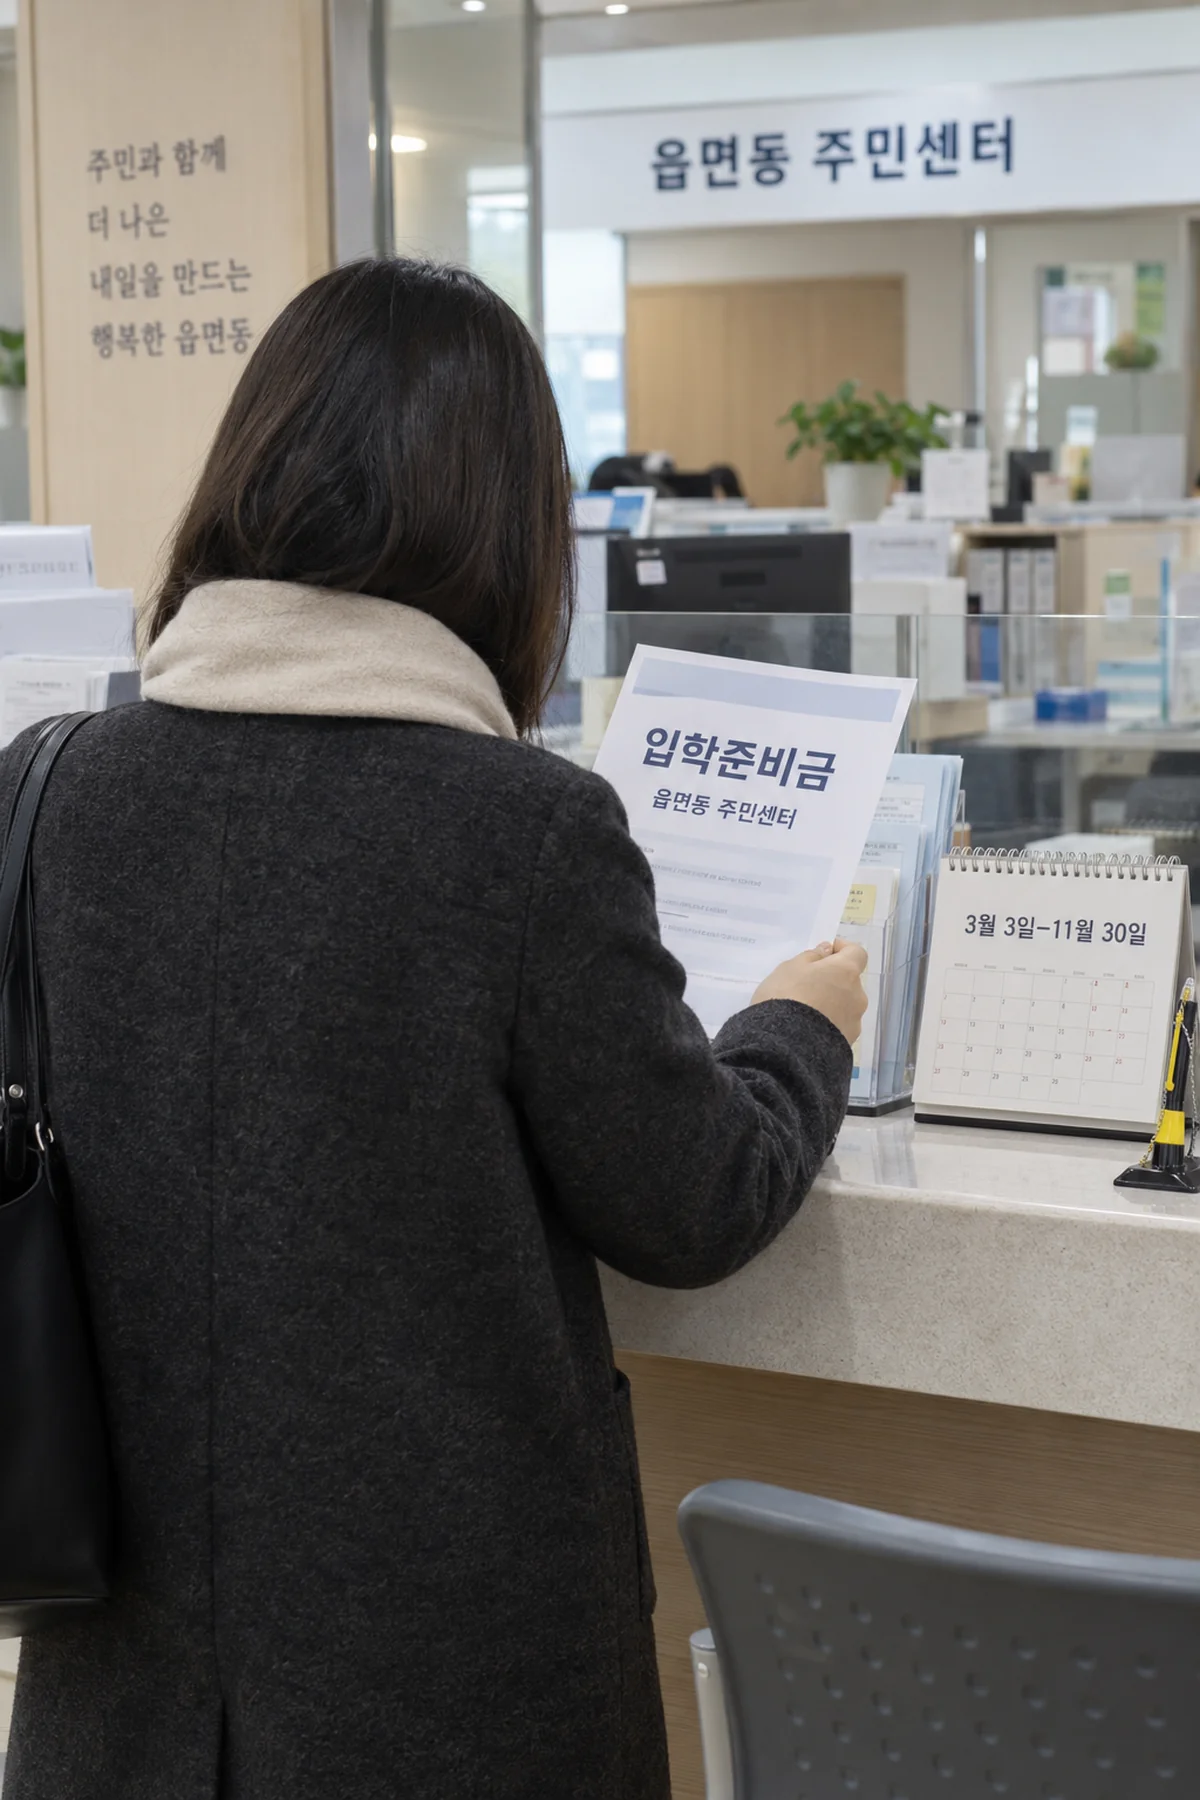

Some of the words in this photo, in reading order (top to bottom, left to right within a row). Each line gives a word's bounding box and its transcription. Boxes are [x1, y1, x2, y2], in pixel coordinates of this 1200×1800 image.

[87, 142, 163, 183] 주민과
[173, 135, 227, 177] 함께
[651, 132, 790, 192] 읍면동
[812, 115, 1013, 183] 주민센터
[87, 205, 109, 241] 더
[119, 202, 170, 239] 나은
[90, 261, 163, 300] 내일을
[173, 258, 252, 296] 만드는
[90, 321, 167, 360] 행복한
[174, 317, 252, 357] 읍면동
[643, 728, 836, 792] 입학준비금
[652, 788, 710, 816] 읍면동
[717, 798, 798, 830] 주민센터
[965, 914, 997, 937] 3월
[1102, 922, 1147, 946] 30일
